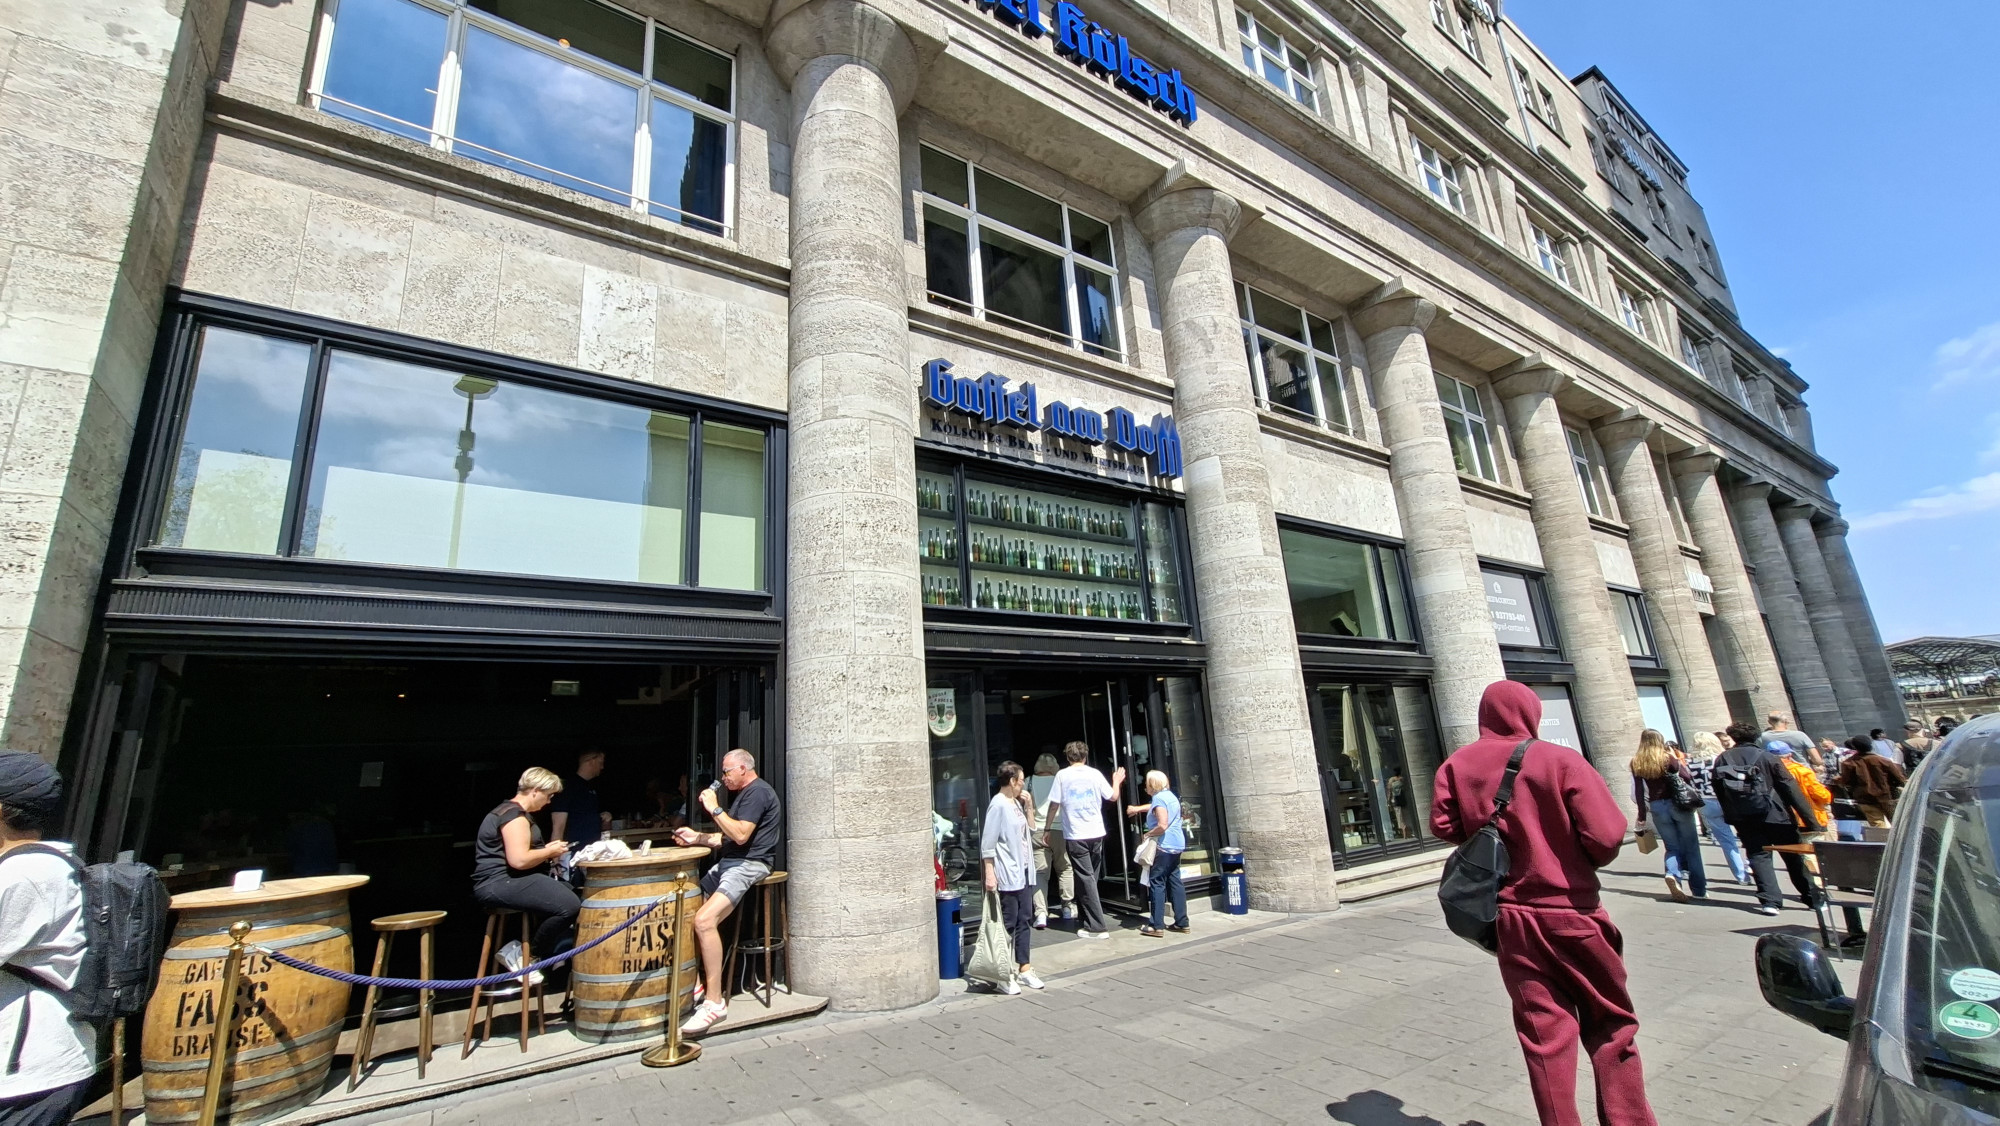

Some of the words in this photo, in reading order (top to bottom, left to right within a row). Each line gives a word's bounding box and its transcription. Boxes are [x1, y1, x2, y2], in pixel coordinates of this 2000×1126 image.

[1051, 1, 1198, 127] Kölsch
[922, 357, 1043, 431] Gaffel
[1044, 400, 1107, 446] am
[1054, 448, 1078, 462] UND
[1962, 1004, 1980, 1020] 4
